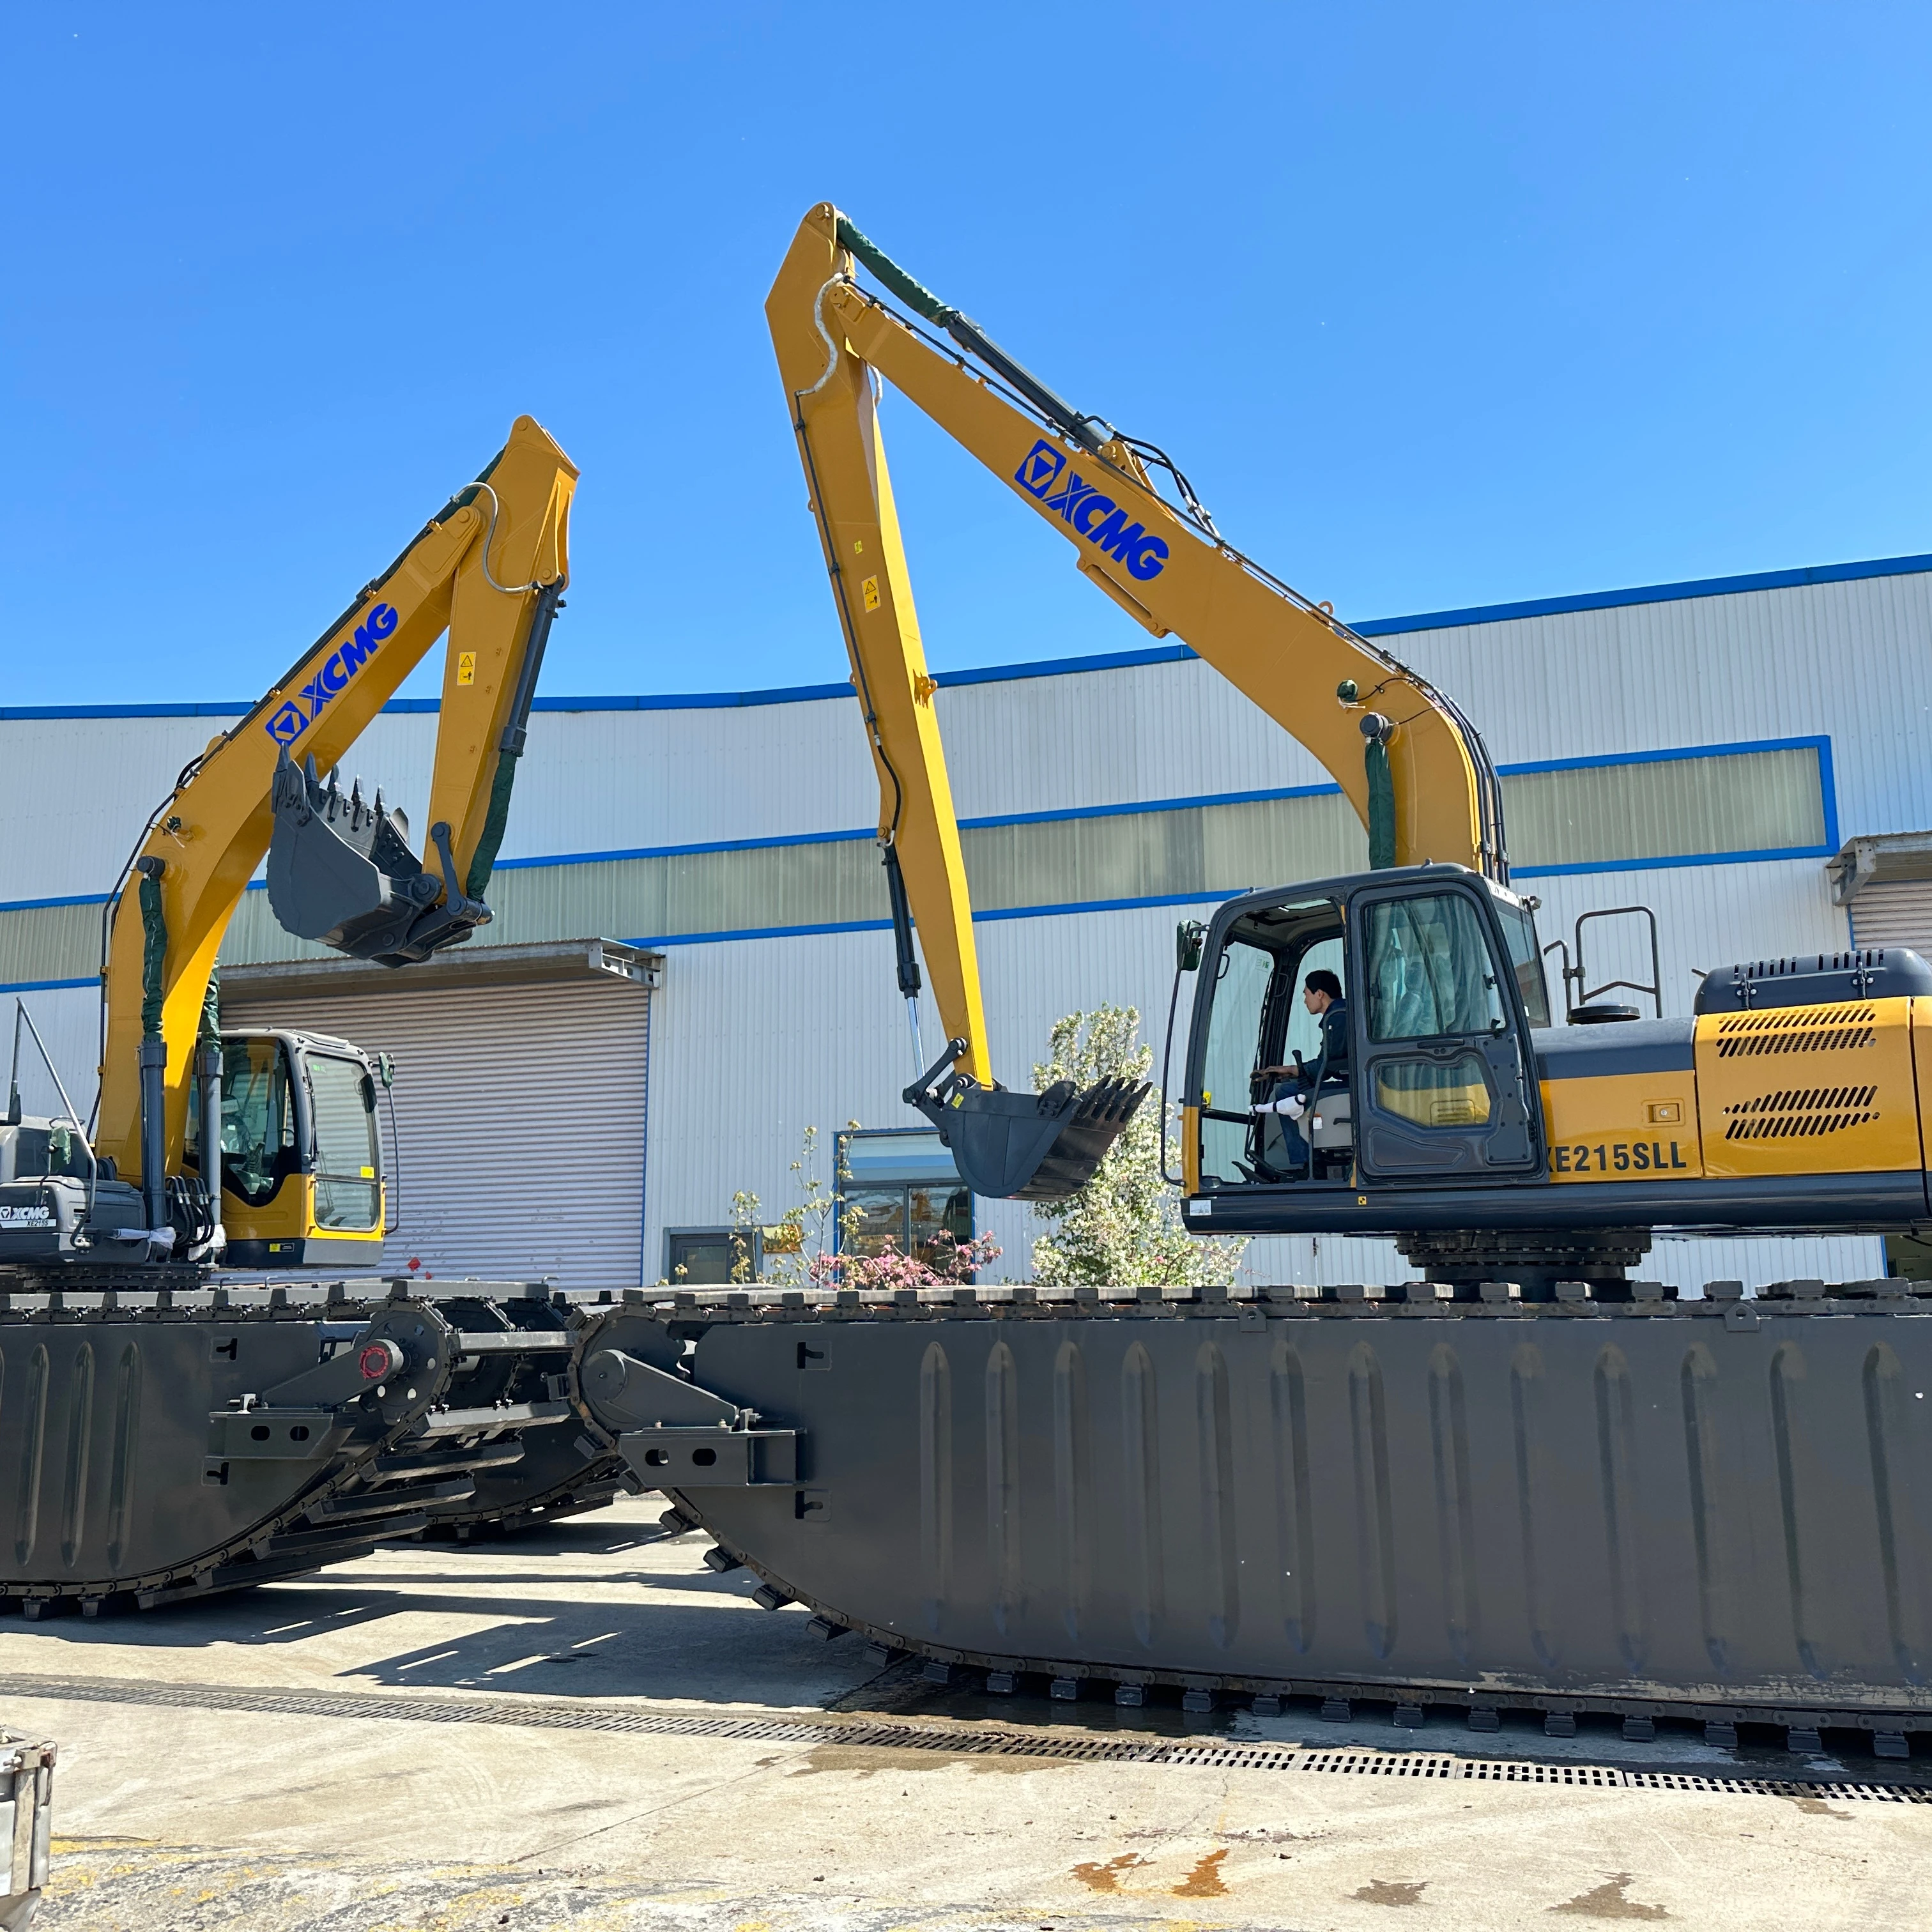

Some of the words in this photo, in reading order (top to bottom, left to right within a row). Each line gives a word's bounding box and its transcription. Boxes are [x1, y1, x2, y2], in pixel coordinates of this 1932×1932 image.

[1043, 470, 1169, 581] XCMG
[298, 602, 399, 723] XCMG
[10, 1206, 50, 1220] XCMG
